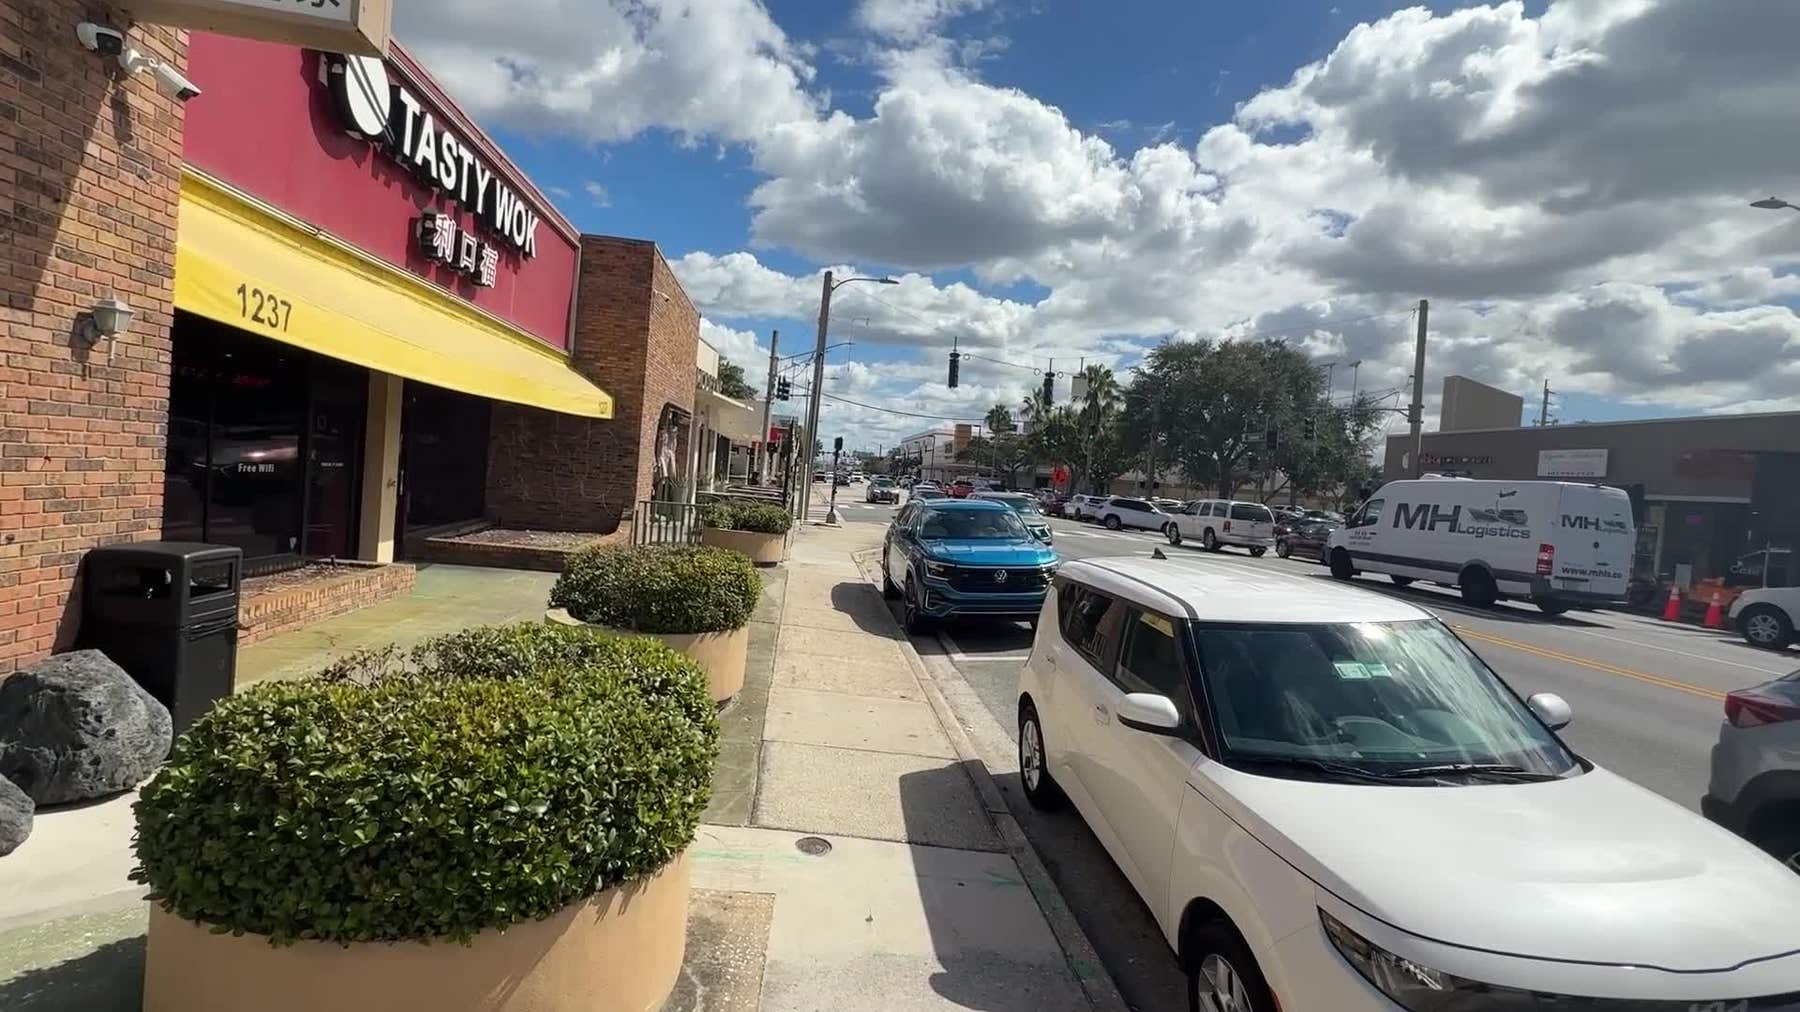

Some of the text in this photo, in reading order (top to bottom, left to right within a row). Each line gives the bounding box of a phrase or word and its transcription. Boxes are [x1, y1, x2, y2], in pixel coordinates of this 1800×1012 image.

[400, 87, 540, 258] TASTY WOK
[237, 283, 292, 332] 1237
[238, 463, 256, 472] Free
[1392, 502, 1531, 539] MH Logistics
[1561, 514, 1599, 530] MH
